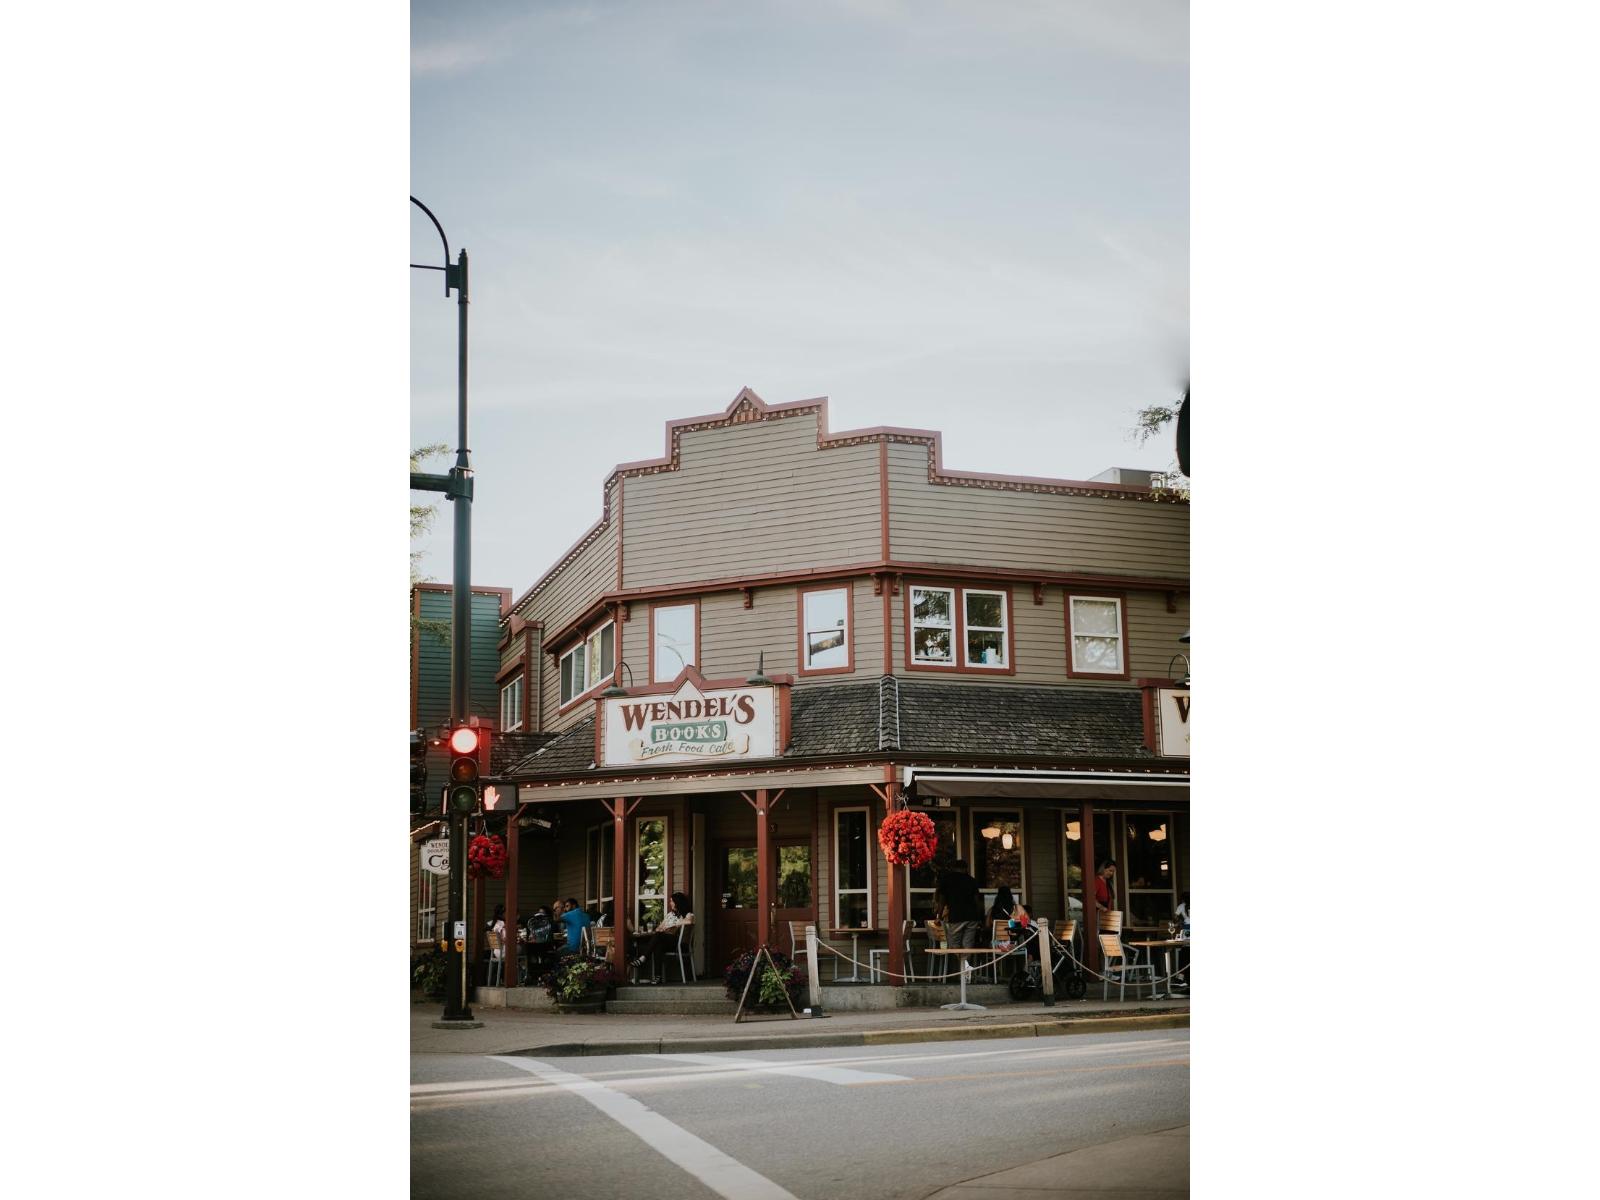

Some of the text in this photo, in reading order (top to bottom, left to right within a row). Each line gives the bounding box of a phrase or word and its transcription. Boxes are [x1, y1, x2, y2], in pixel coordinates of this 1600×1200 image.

[620, 694, 755, 732] WENDEL'S
[655, 724, 721, 742] BOOKS
[641, 743, 673, 757] Fresh
[679, 742, 703, 753] Food
